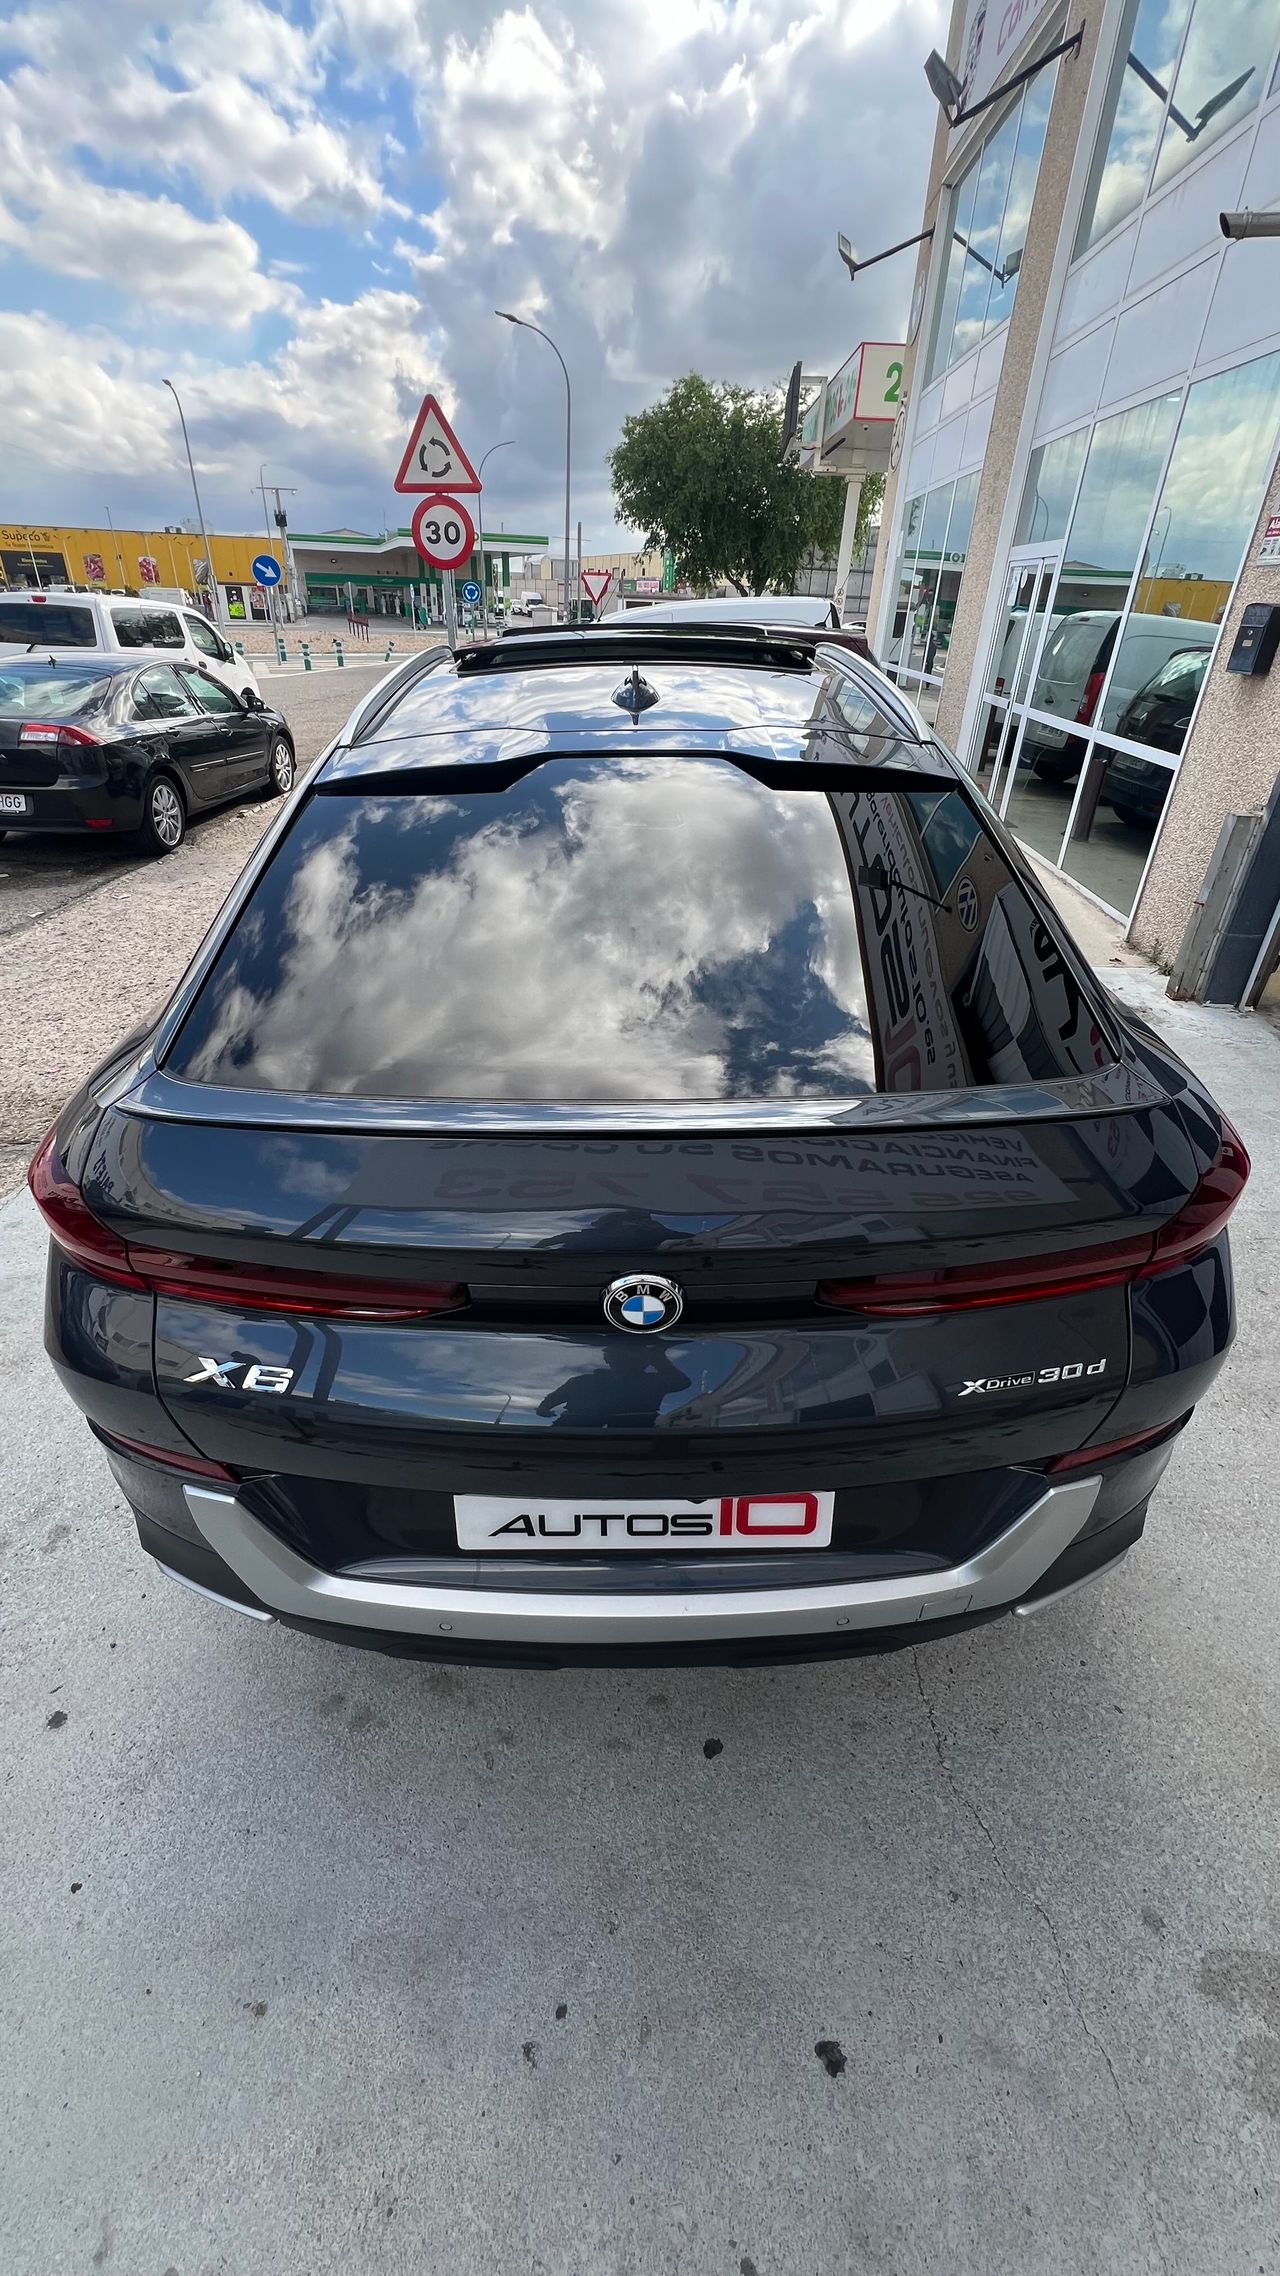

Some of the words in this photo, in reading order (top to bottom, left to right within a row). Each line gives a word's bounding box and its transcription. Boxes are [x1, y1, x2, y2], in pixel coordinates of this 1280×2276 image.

[425, 520, 461, 545] 30
[615, 1285, 673, 1303] BMW
[183, 1356, 294, 1394] X6
[488, 1493, 819, 1537] AUTOS10
